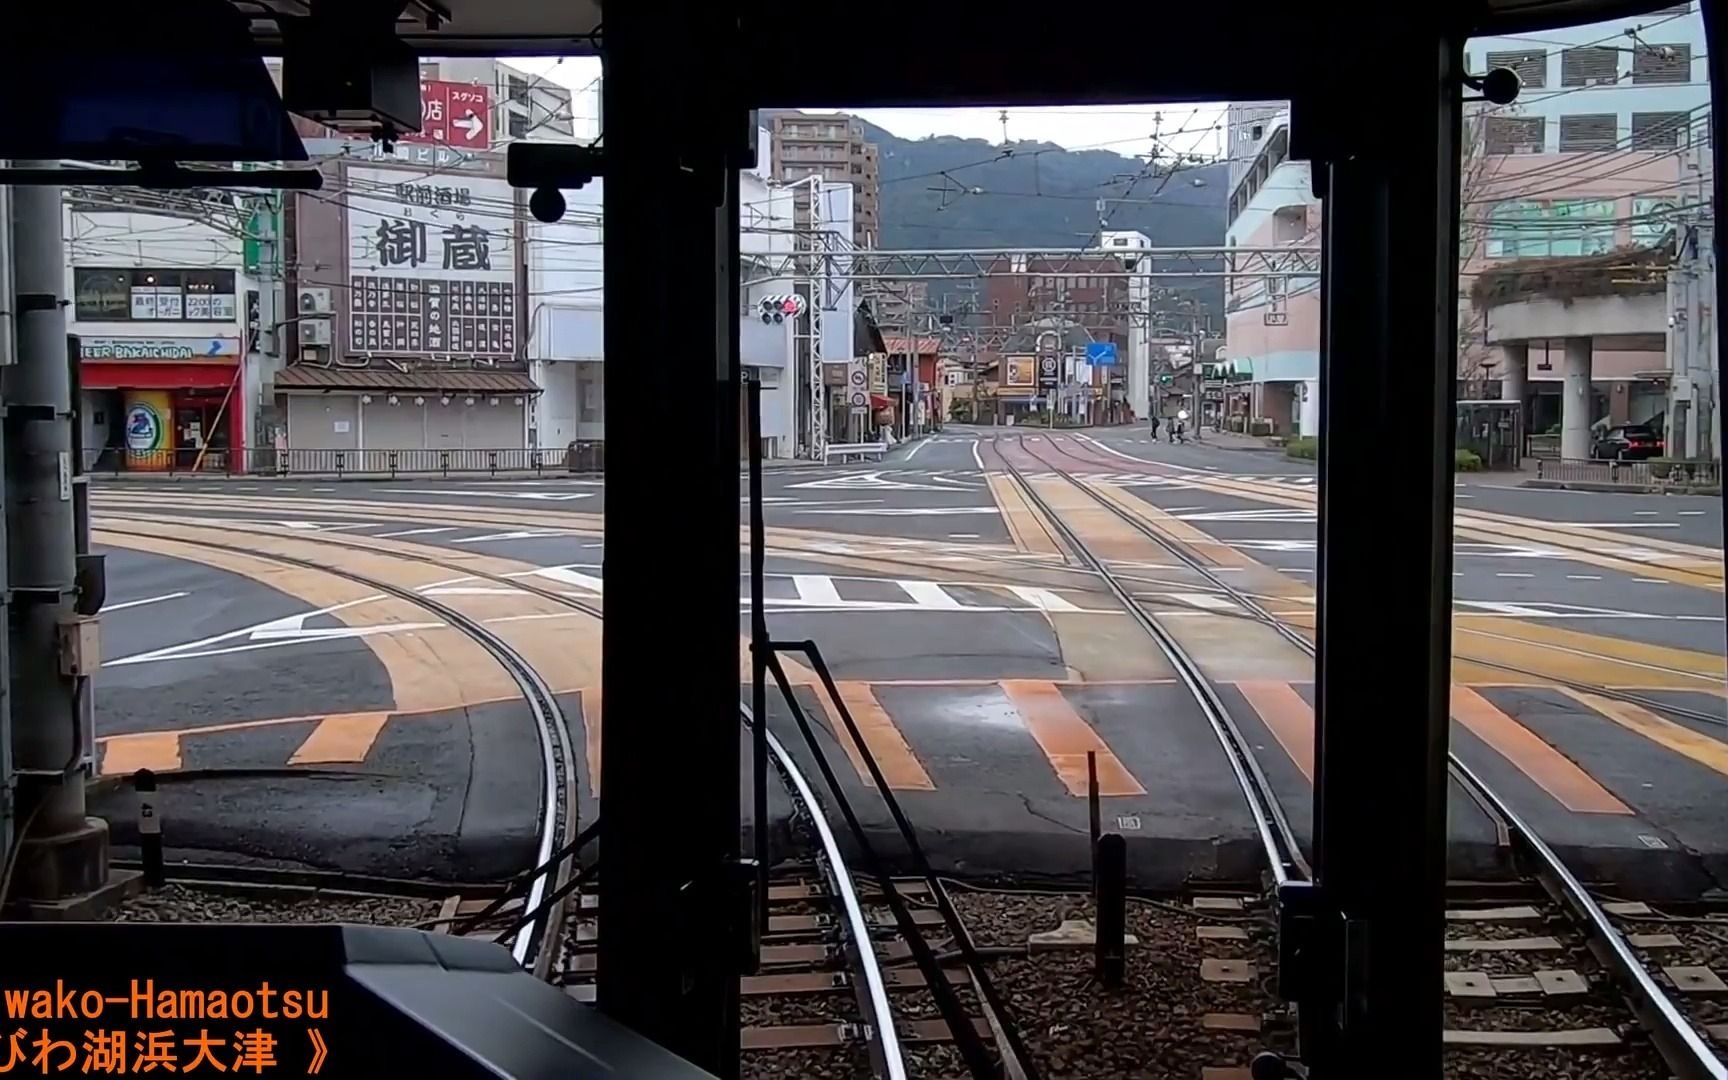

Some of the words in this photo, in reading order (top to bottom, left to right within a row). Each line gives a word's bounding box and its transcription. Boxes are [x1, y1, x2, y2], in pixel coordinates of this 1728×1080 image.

[451, 91, 484, 103] スグソコ
[395, 183, 472, 206] 駅前酒場
[375, 218, 492, 271] 御蔵
[113, 345, 194, 359] BAKAICHIDAI
